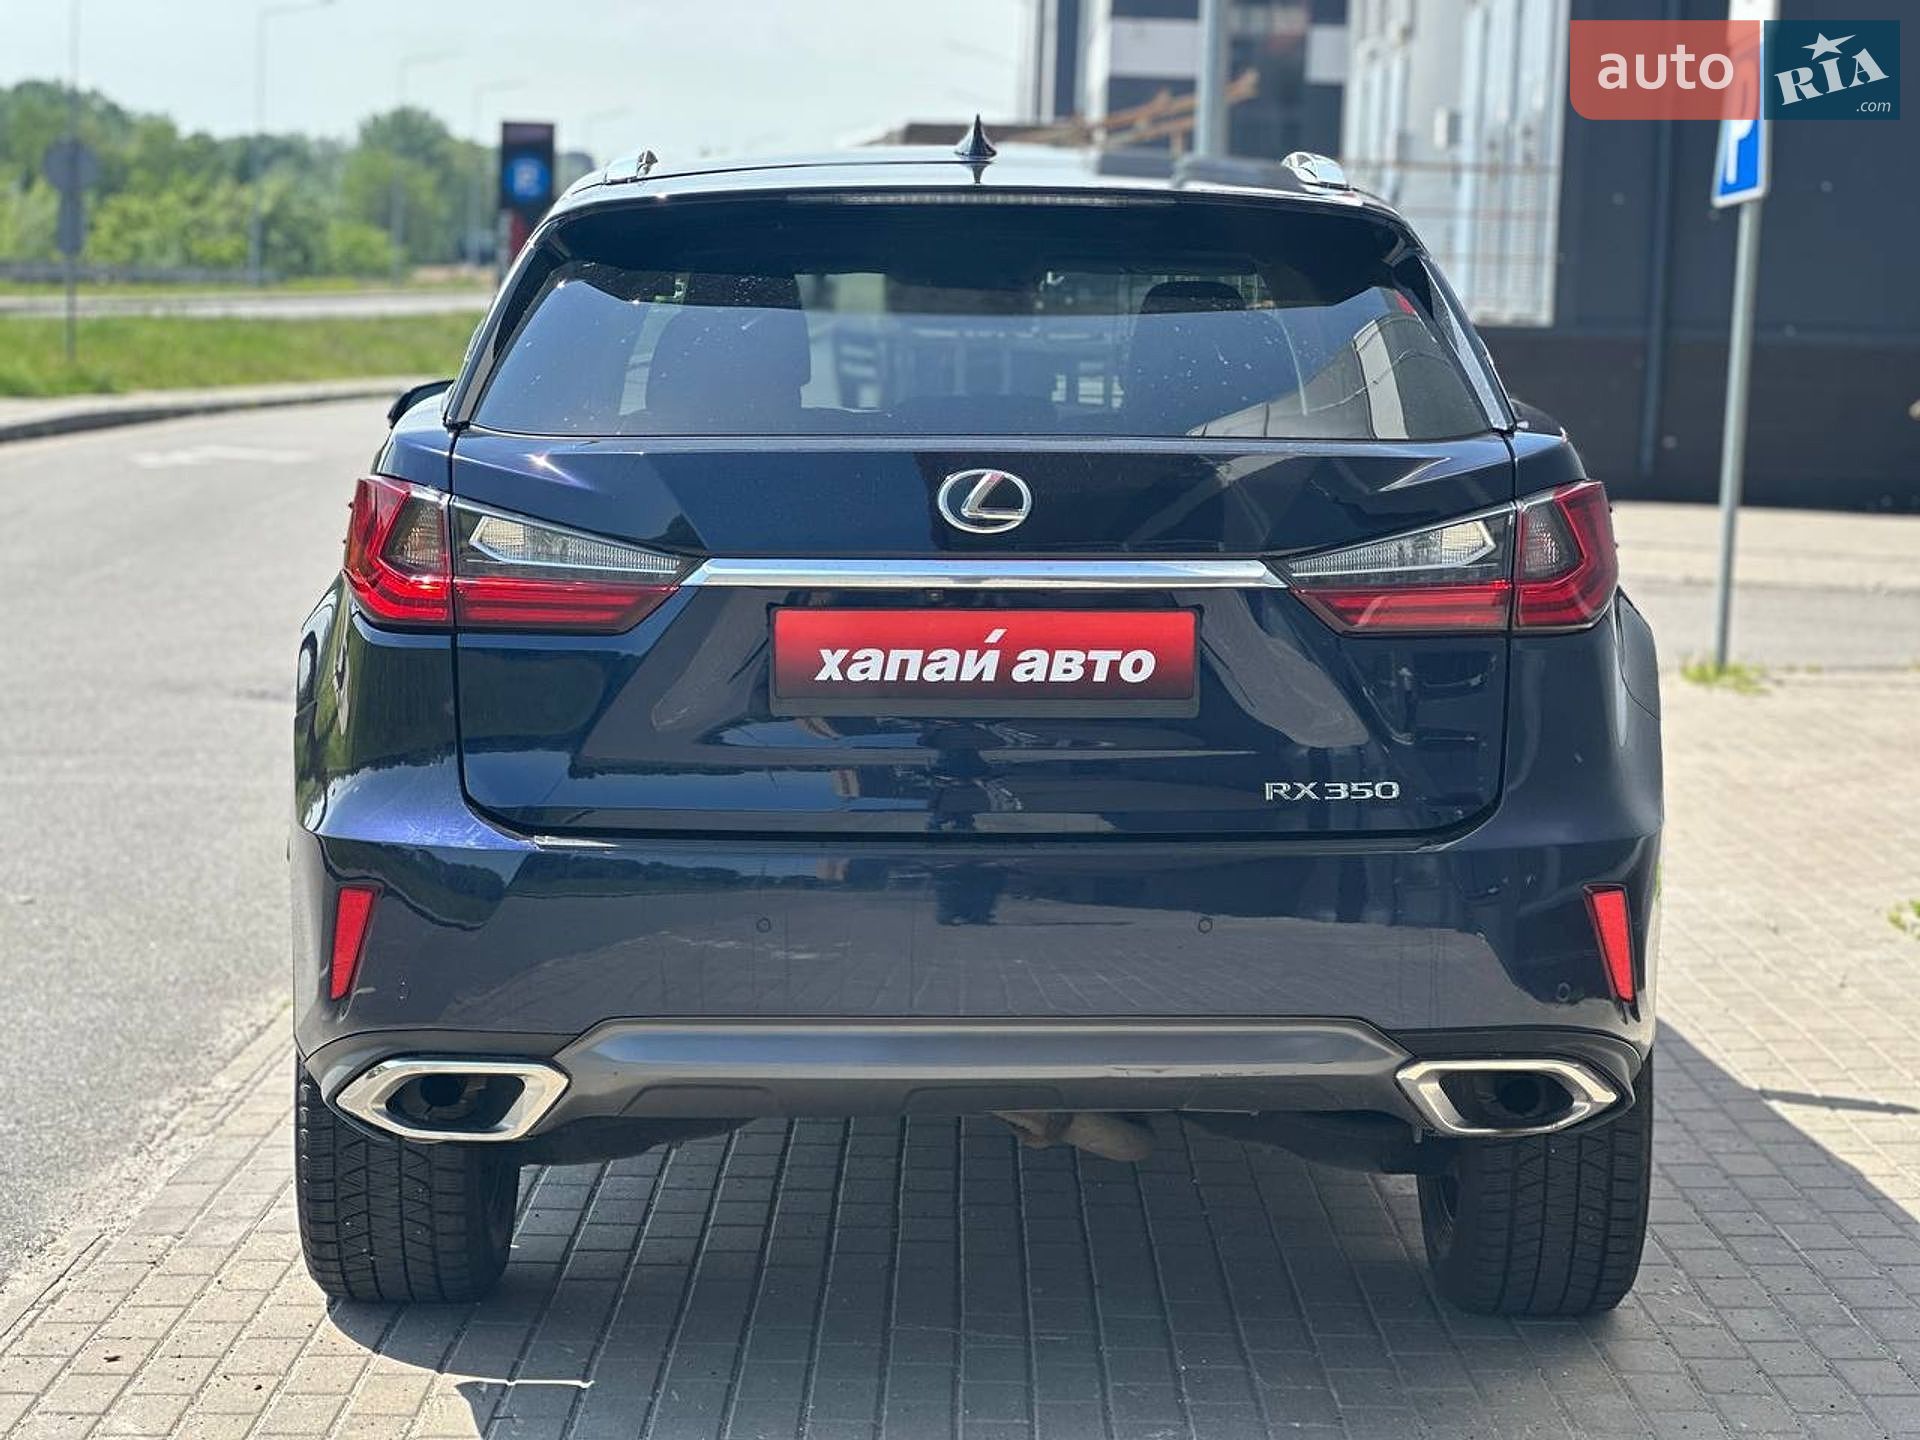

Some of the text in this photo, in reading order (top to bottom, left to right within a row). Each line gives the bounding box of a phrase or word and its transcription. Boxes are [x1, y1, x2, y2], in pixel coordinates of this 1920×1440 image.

[1011, 649, 1156, 683] авто
[1265, 781, 1400, 800] RX 350
